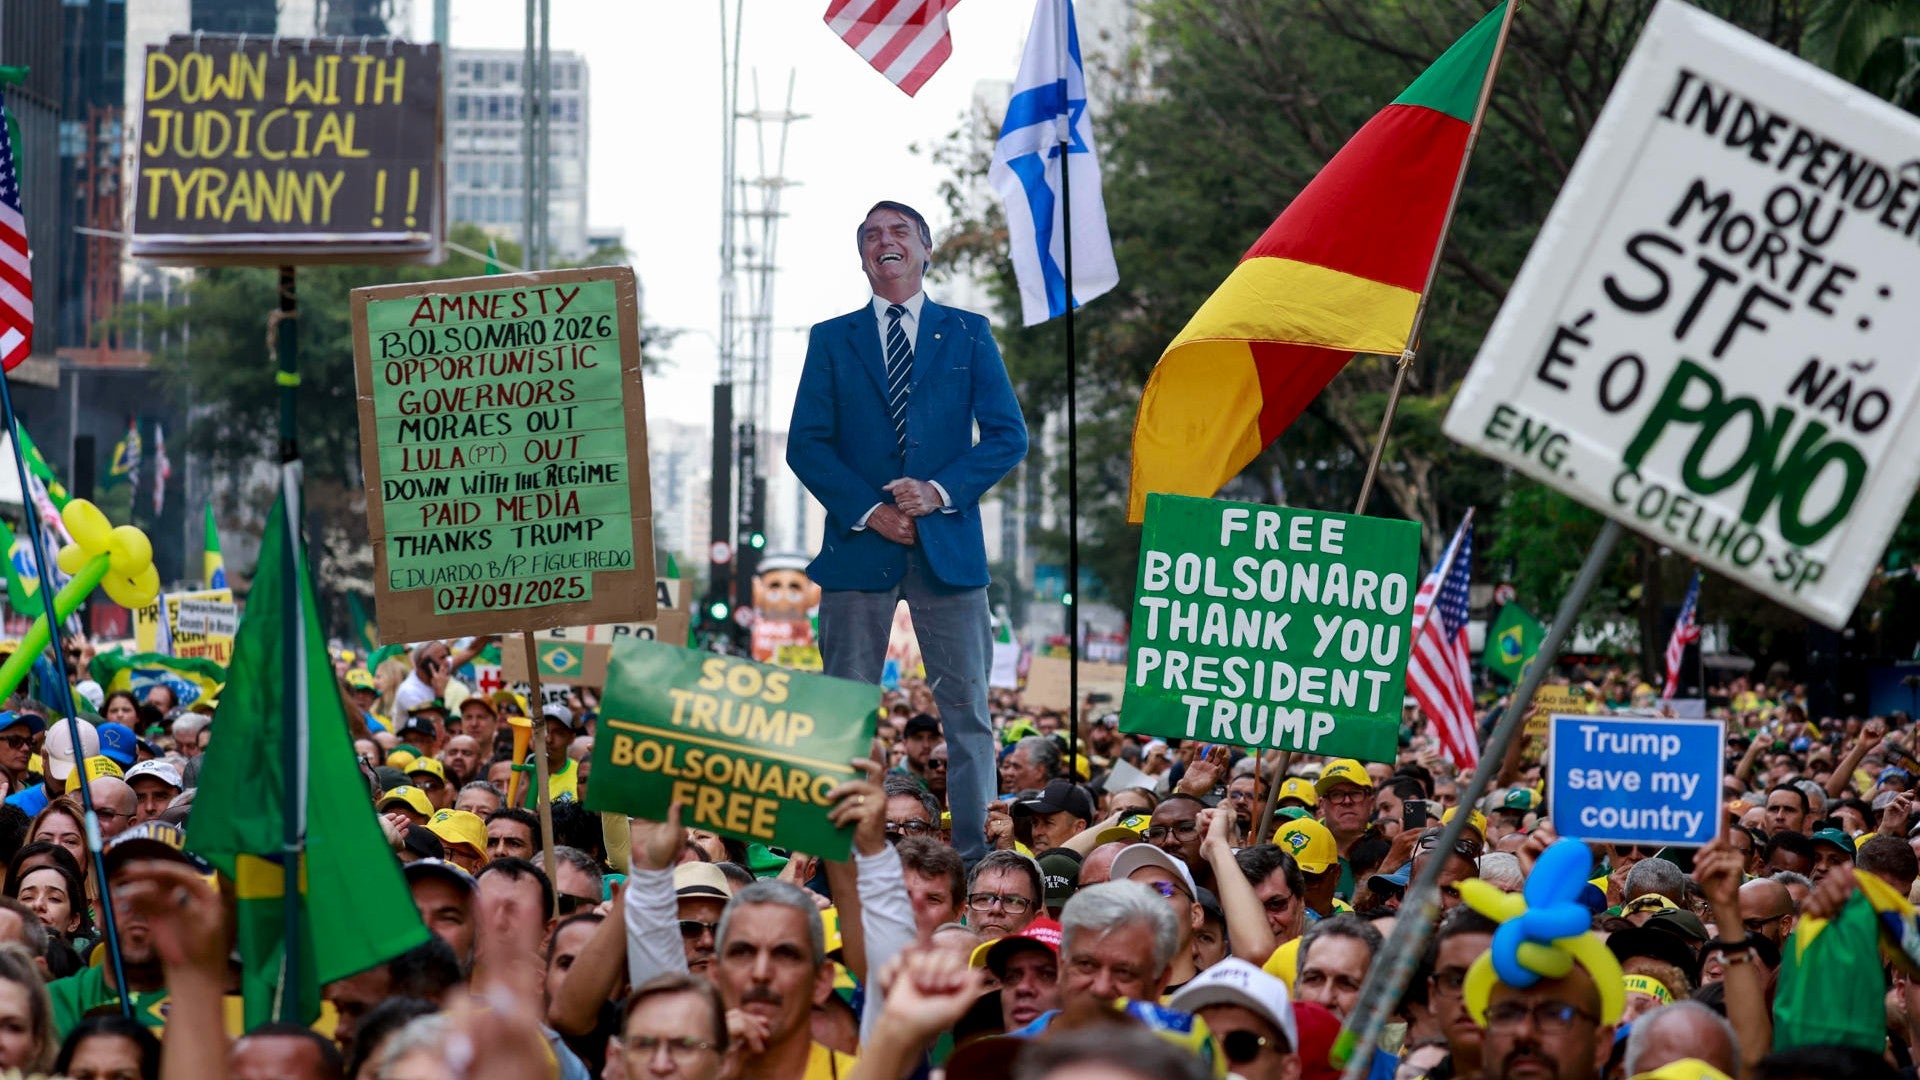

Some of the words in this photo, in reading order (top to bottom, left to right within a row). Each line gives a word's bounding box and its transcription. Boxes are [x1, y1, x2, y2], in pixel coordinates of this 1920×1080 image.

[144, 51, 267, 104] DOWN
[286, 54, 405, 105] WITH
[142, 108, 370, 160] JUDICIAL
[142, 167, 346, 226] TYRANNY
[1764, 185, 1845, 247] OU
[409, 285, 581, 328] AMNESTY
[379, 320, 547, 360] BOLSONARO
[552, 314, 613, 342] 2026
[1536, 311, 1595, 392] É
[1603, 232, 1791, 359] STF
[1786, 357, 1891, 435] NÃO
[385, 343, 599, 386] OPPORTUNISTIC
[1599, 352, 1646, 414] O
[398, 379, 577, 416] GOVERNORS
[397, 412, 513, 444] MORAES
[526, 405, 579, 436] OUT
[523, 434, 586, 464] OUT
[1483, 404, 1577, 481] ENG.
[1622, 357, 1869, 548] POVO
[384, 476, 451, 502] DOWN
[461, 470, 509, 495] WITH
[514, 471, 542, 491] THE
[544, 460, 620, 488] REGIME
[418, 499, 482, 528] PAID
[496, 488, 581, 523] MEDIA
[1220, 508, 1347, 555] FREE
[394, 529, 492, 558] THANKS
[510, 518, 604, 548] TRUMP
[390, 563, 483, 589] EDUARDO
[437, 576, 586, 612] 07/09/2025
[1143, 550, 1408, 615] BOLSONARO
[1139, 596, 1292, 651] THANK
[1312, 614, 1401, 667] YOU
[697, 657, 792, 704] SOS
[1135, 647, 1392, 713] PRESIDENT
[669, 687, 815, 748] TRUMP
[1181, 695, 1336, 751] TRUMP
[1579, 725, 1682, 762] Trump
[610, 734, 840, 807] BOLSONARO
[1567, 768, 1642, 792] save
[1651, 770, 1701, 802] my
[671, 781, 780, 840] FREE
[1580, 804, 1705, 839] country
